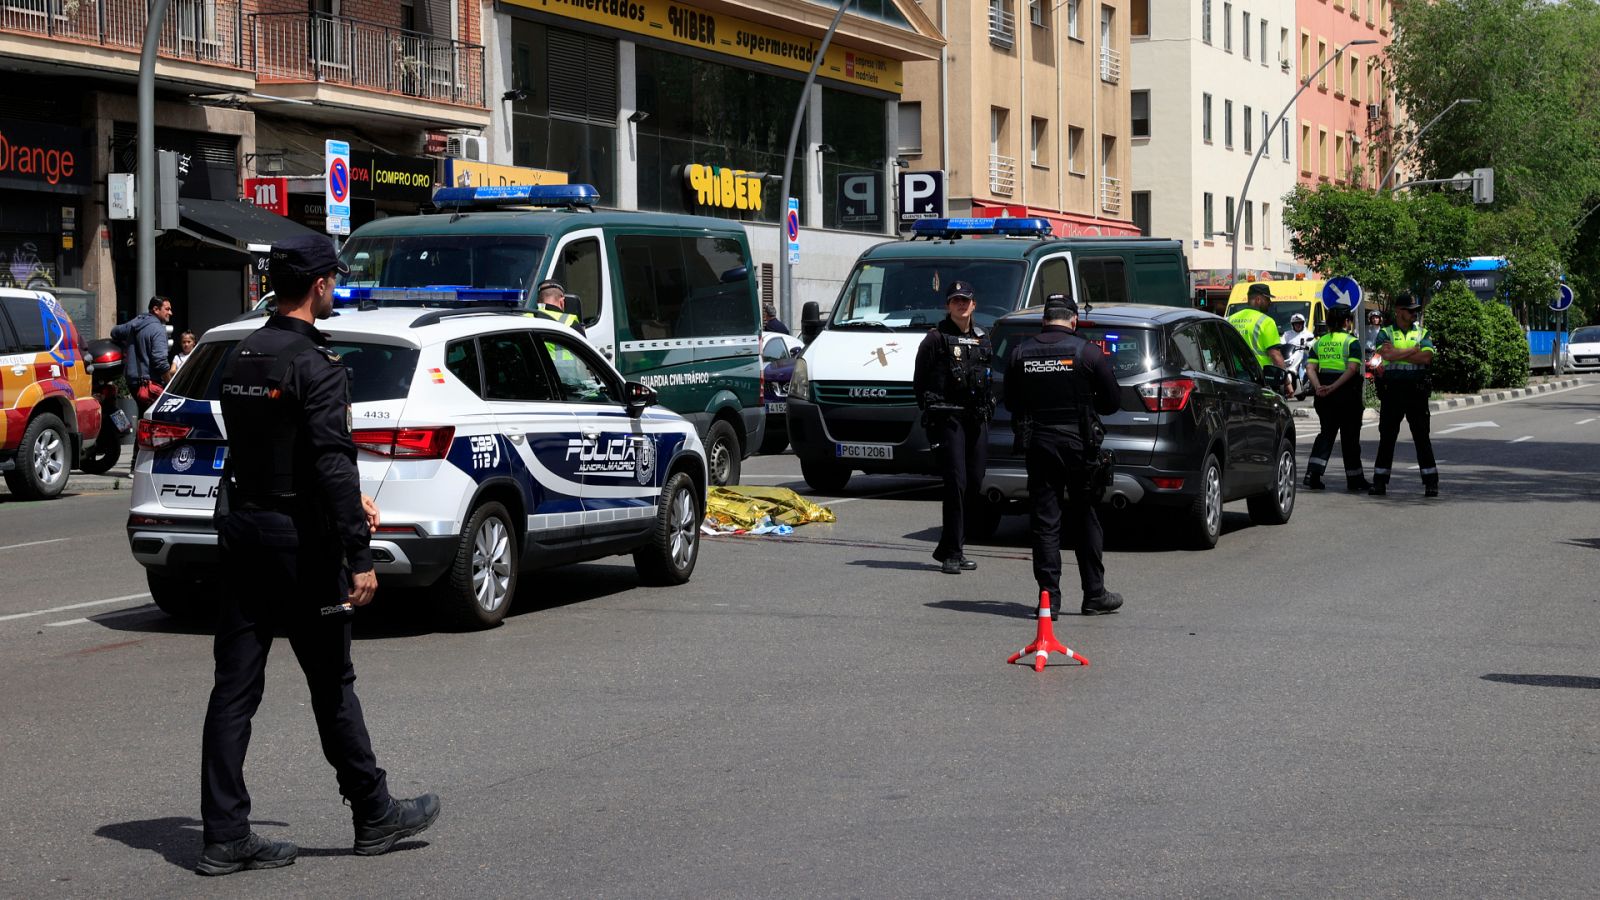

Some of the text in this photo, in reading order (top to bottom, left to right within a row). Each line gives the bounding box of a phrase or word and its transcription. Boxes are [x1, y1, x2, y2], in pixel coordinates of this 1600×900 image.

[541, 0, 645, 21] mercados
[668, 5, 716, 45] HIBER
[375, 169, 411, 186] COMPRO
[412, 174, 430, 188] ORO
[690, 163, 762, 211] HIBER
[904, 173, 936, 213] P
[1024, 366, 1074, 374] NACIONAL
[640, 370, 710, 388] GUARDIA CIVIL TRÁFICO
[222, 383, 271, 397] POLICIA
[848, 387, 887, 398] IVECO
[363, 411, 391, 419] 4433
[842, 445, 860, 456] PGC
[863, 447, 885, 458] 1206
[472, 453, 491, 470] 112
[607, 461, 636, 471] MADRID
